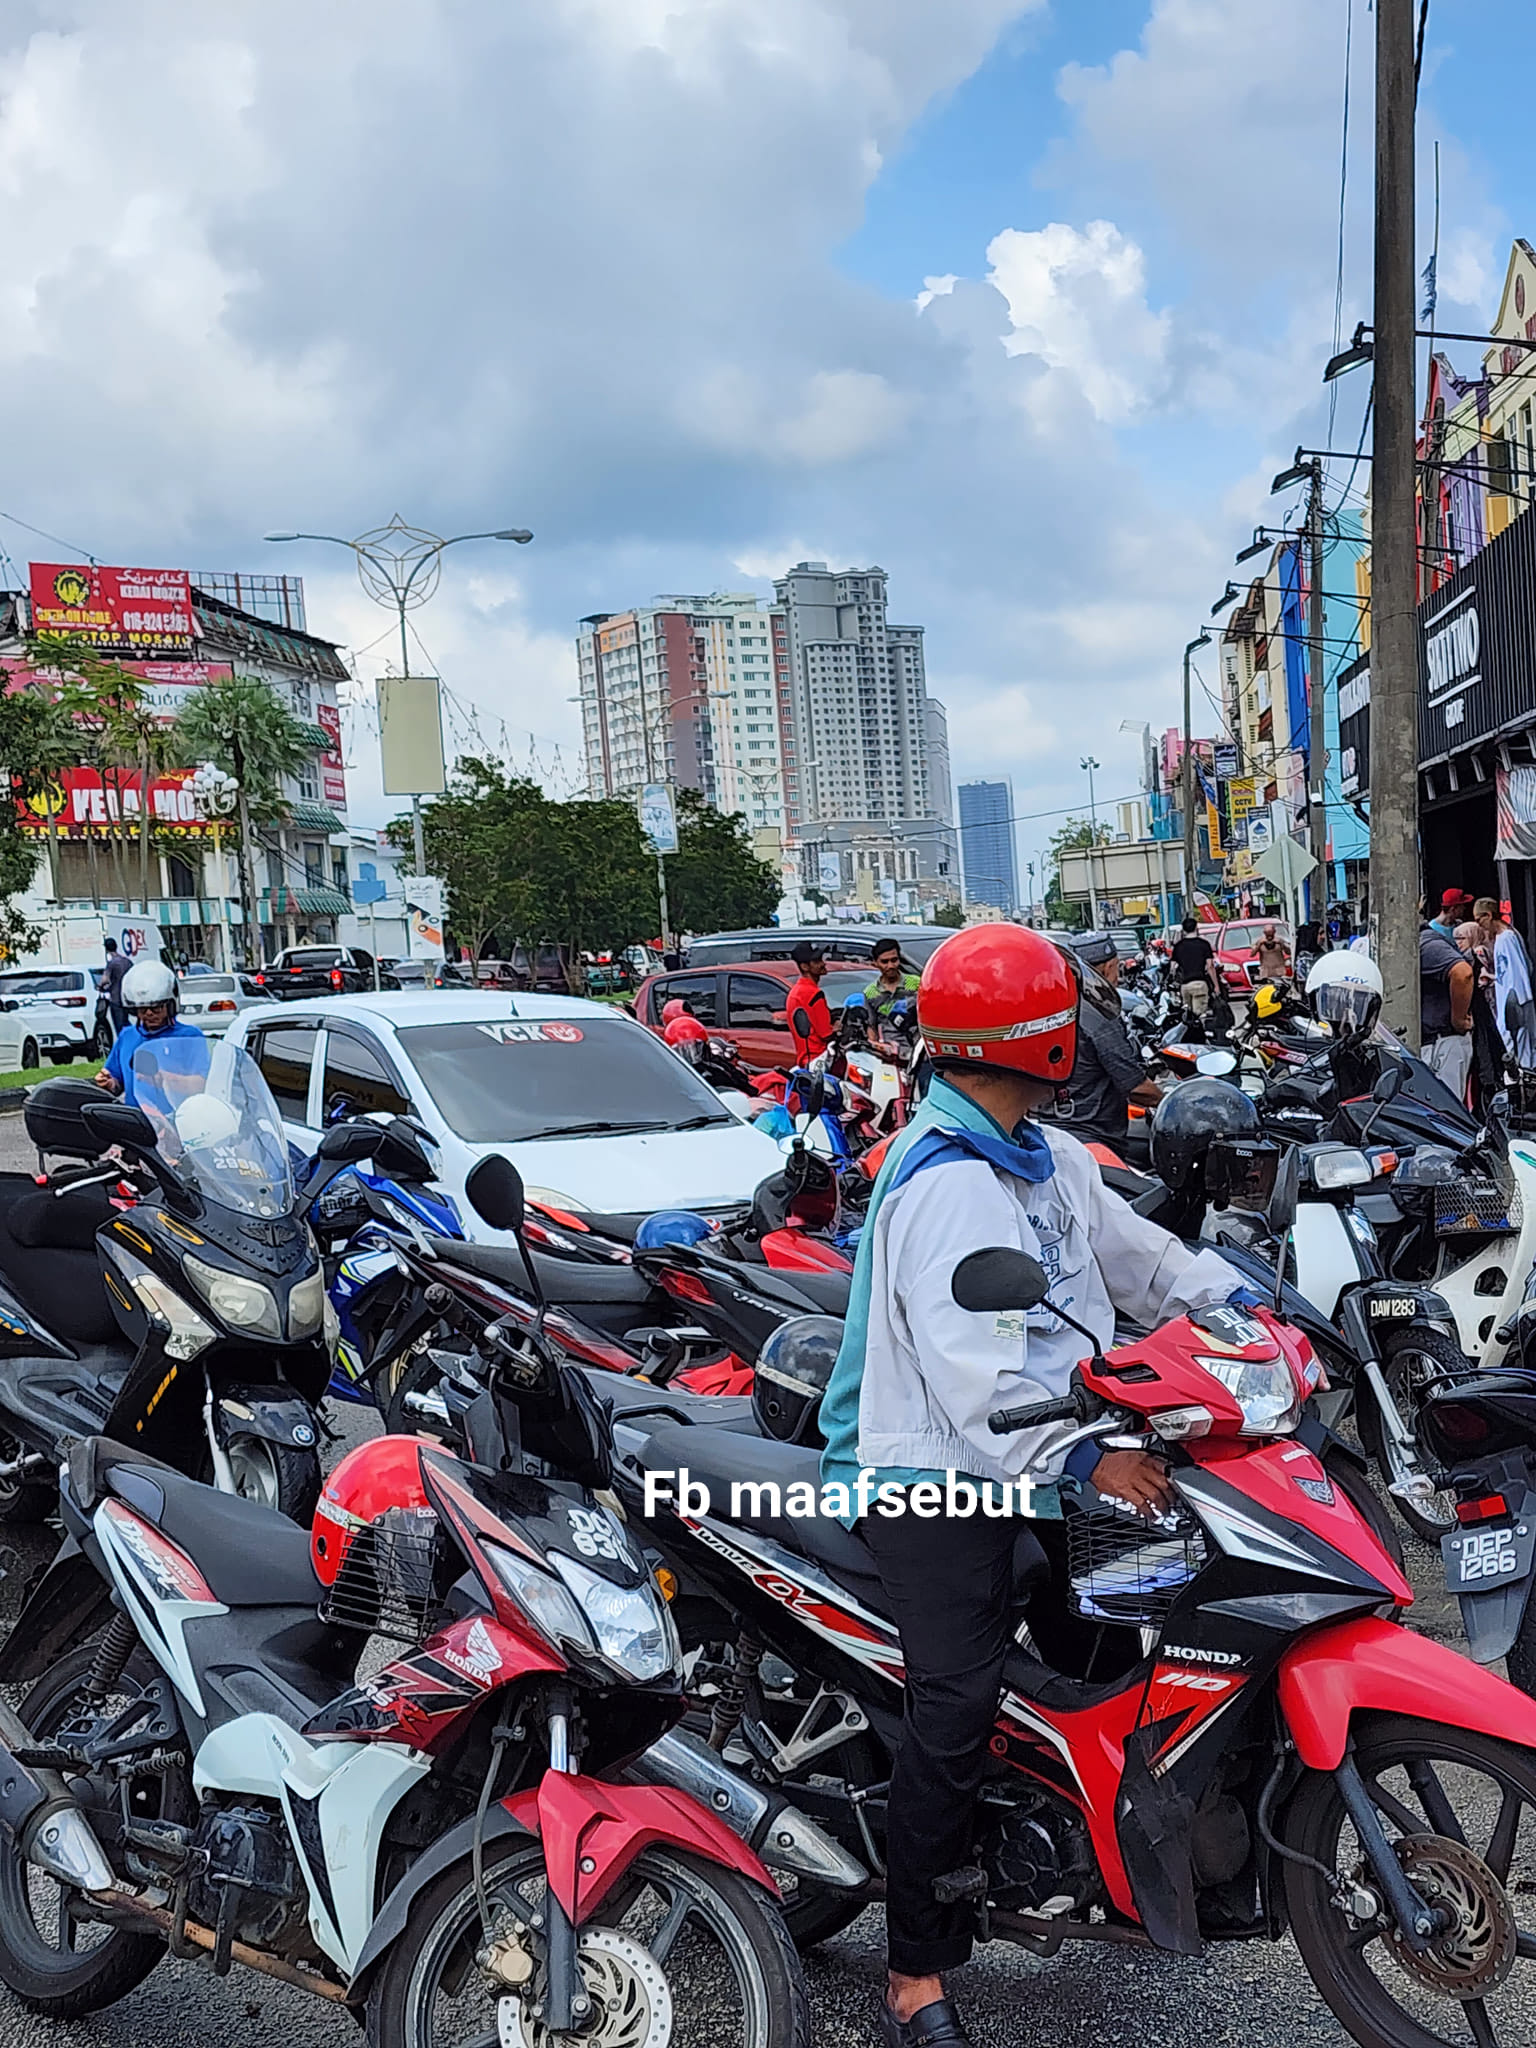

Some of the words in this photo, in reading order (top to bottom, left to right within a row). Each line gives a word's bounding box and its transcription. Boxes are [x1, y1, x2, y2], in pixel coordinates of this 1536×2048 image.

[1391, 1299, 1416, 1317] 1283
[1462, 1527, 1513, 1561] DEP
[1460, 1549, 1517, 1582] 1266
[443, 1647, 493, 1687] HONDA
[1155, 1672, 1232, 1692] 110
